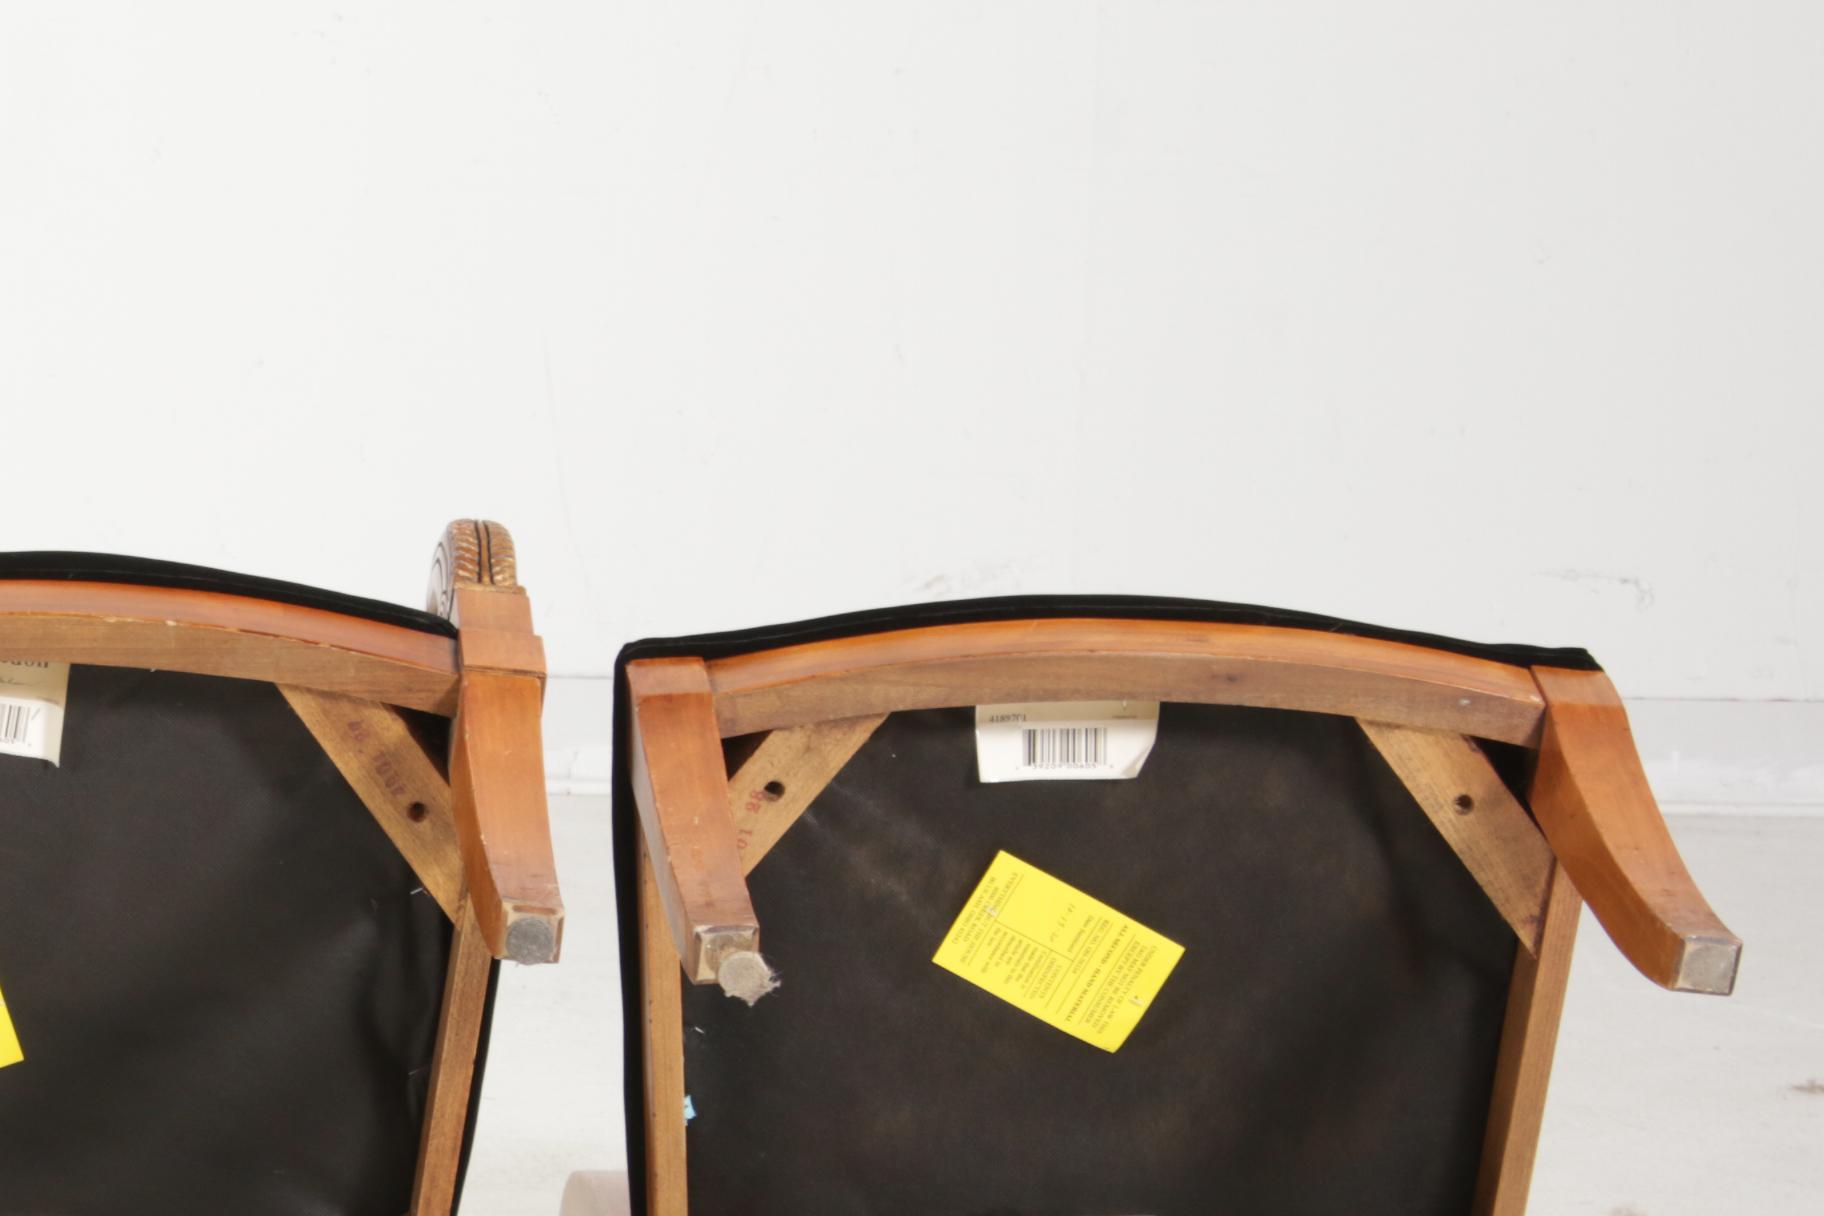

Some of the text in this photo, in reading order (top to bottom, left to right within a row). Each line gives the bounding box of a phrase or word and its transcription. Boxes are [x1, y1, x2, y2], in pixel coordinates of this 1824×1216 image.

[1117, 923, 1130, 937] ALL
[1099, 937, 1122, 965] SECOND
[1084, 967, 1102, 989] HAND
[1063, 987, 1090, 1023] MATERIAL
